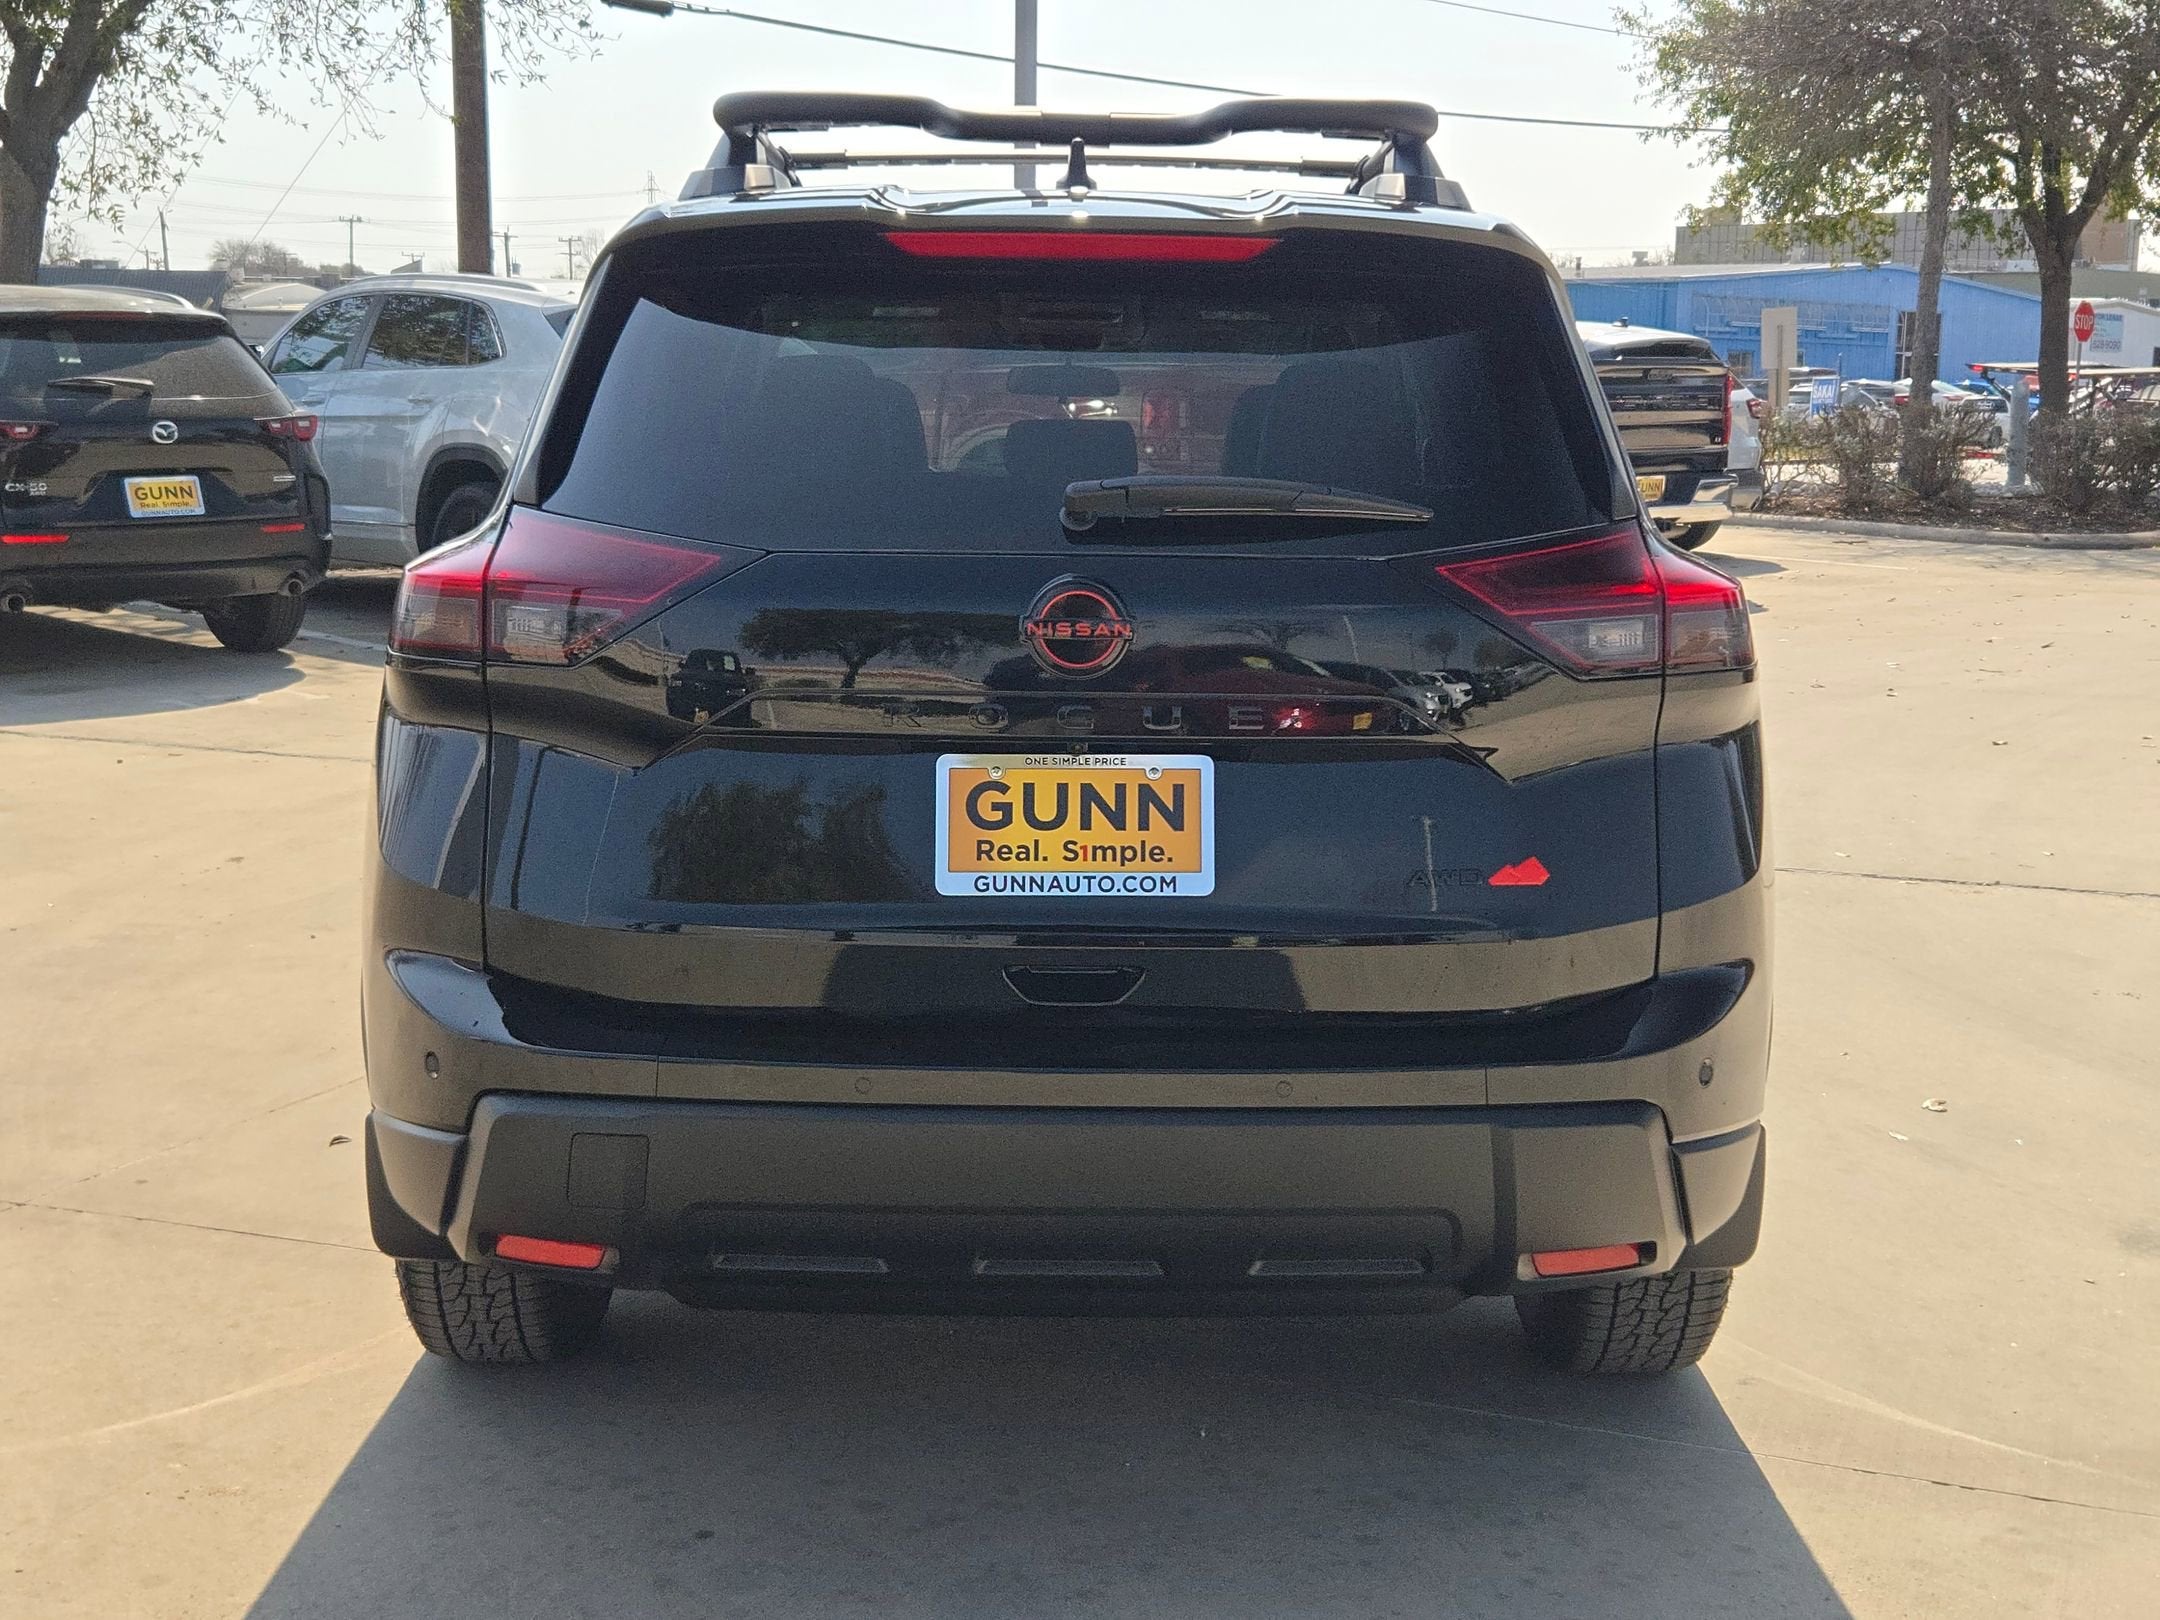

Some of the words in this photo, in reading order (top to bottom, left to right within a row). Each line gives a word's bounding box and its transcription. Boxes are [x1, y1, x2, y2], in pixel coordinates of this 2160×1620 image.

[2075, 314, 2094, 330] STOP
[134, 485, 194, 500] GUNN
[1026, 622, 1133, 637] NISSAN
[882, 704, 1265, 730] ROGUE
[1024, 757, 1048, 766] ONE
[1052, 757, 1091, 766] SIMPLE
[1094, 757, 1127, 766] PRICE
[965, 780, 1185, 832] GUNN
[976, 838, 1049, 862] Real.
[973, 875, 1178, 893] GUNNAUTO.COM
[1405, 868, 1483, 887] AWD
